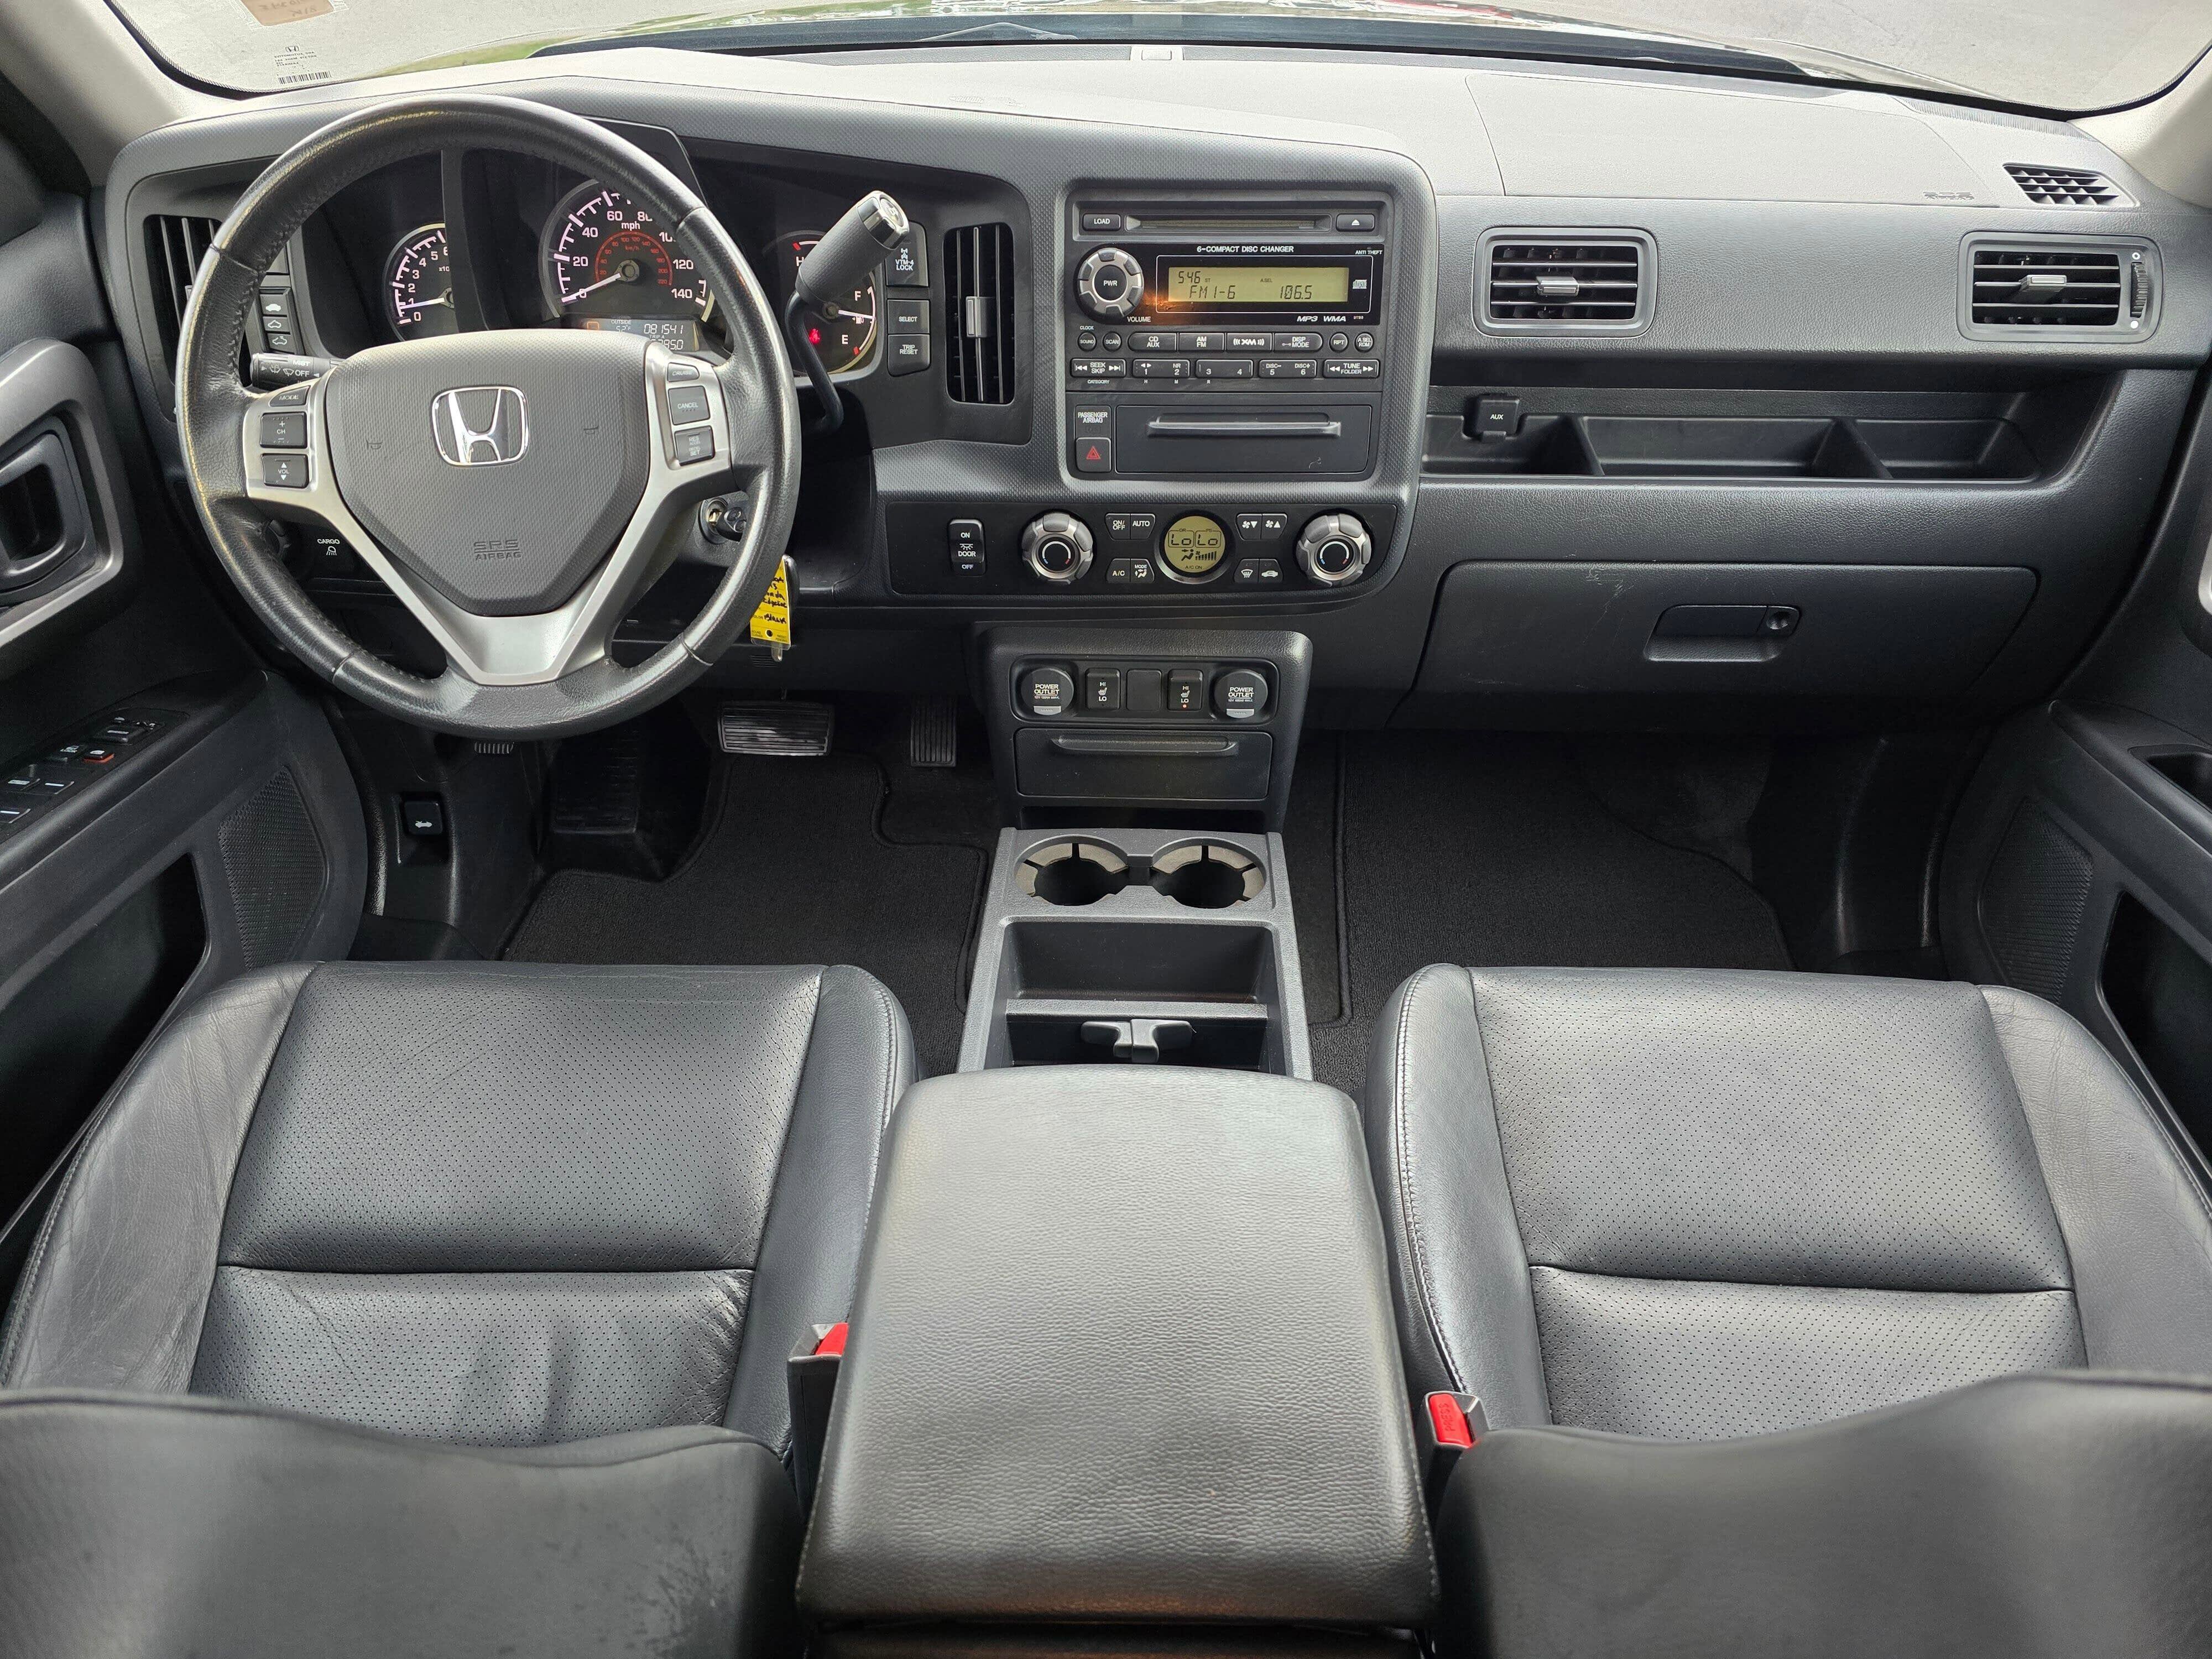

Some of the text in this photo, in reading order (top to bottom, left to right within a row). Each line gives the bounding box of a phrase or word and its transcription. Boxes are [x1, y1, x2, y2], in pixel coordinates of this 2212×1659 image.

[607, 211, 623, 221] 60
[621, 221, 640, 231] mph
[582, 227, 598, 238] 40
[659, 232, 676, 242] 10
[431, 251, 438, 260] 5
[419, 258, 427, 267] 4
[573, 256, 588, 267] 20
[672, 259, 693, 270] 120
[796, 257, 805, 266] H
[412, 270, 420, 279] 3
[408, 283, 415, 293] 2
[1280, 285, 1312, 299] 106.5
[671, 288, 692, 299] 140
[854, 291, 861, 301] F
[414, 312, 421, 321] 0
[644, 324, 684, 334] 081541
[842, 335, 848, 345] E
[475, 552, 521, 561] AIRBAG
